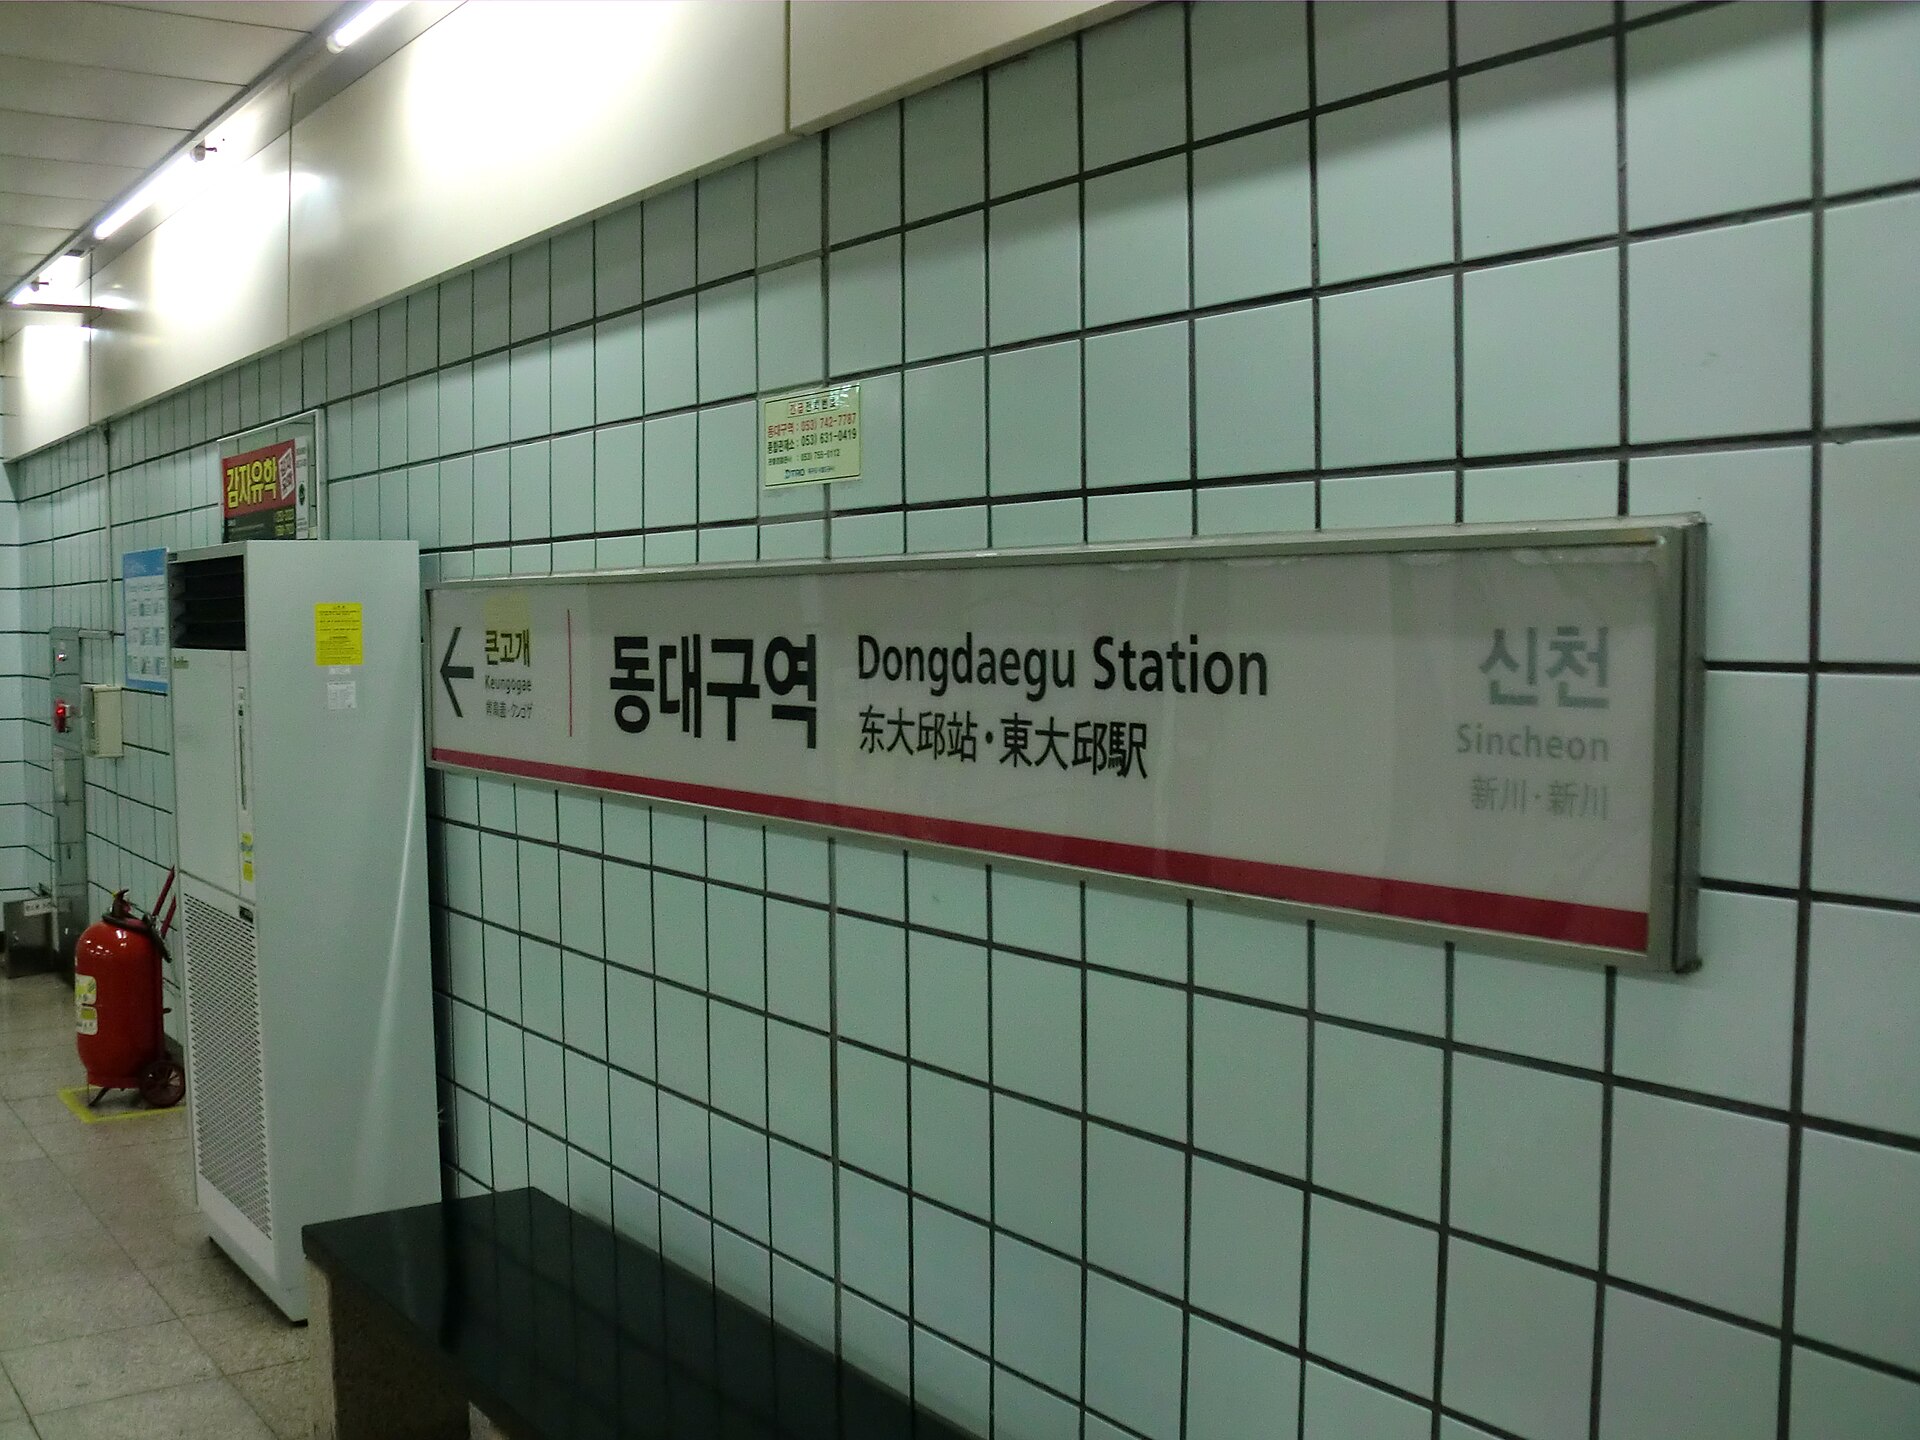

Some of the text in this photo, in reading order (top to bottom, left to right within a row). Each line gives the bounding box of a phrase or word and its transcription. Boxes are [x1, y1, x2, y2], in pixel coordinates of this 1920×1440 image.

[768, 422, 794, 438] 동대구역
[820, 428, 857, 444] 631-0419
[226, 456, 278, 509] 감자유학
[484, 629, 531, 668] 큰고개
[857, 632, 1268, 702] Dongdaegu Station
[1479, 626, 1610, 709] 신천
[485, 675, 532, 695] Keungogae
[610, 634, 816, 749] 동대구역
[1456, 723, 1609, 763] Sincheon
